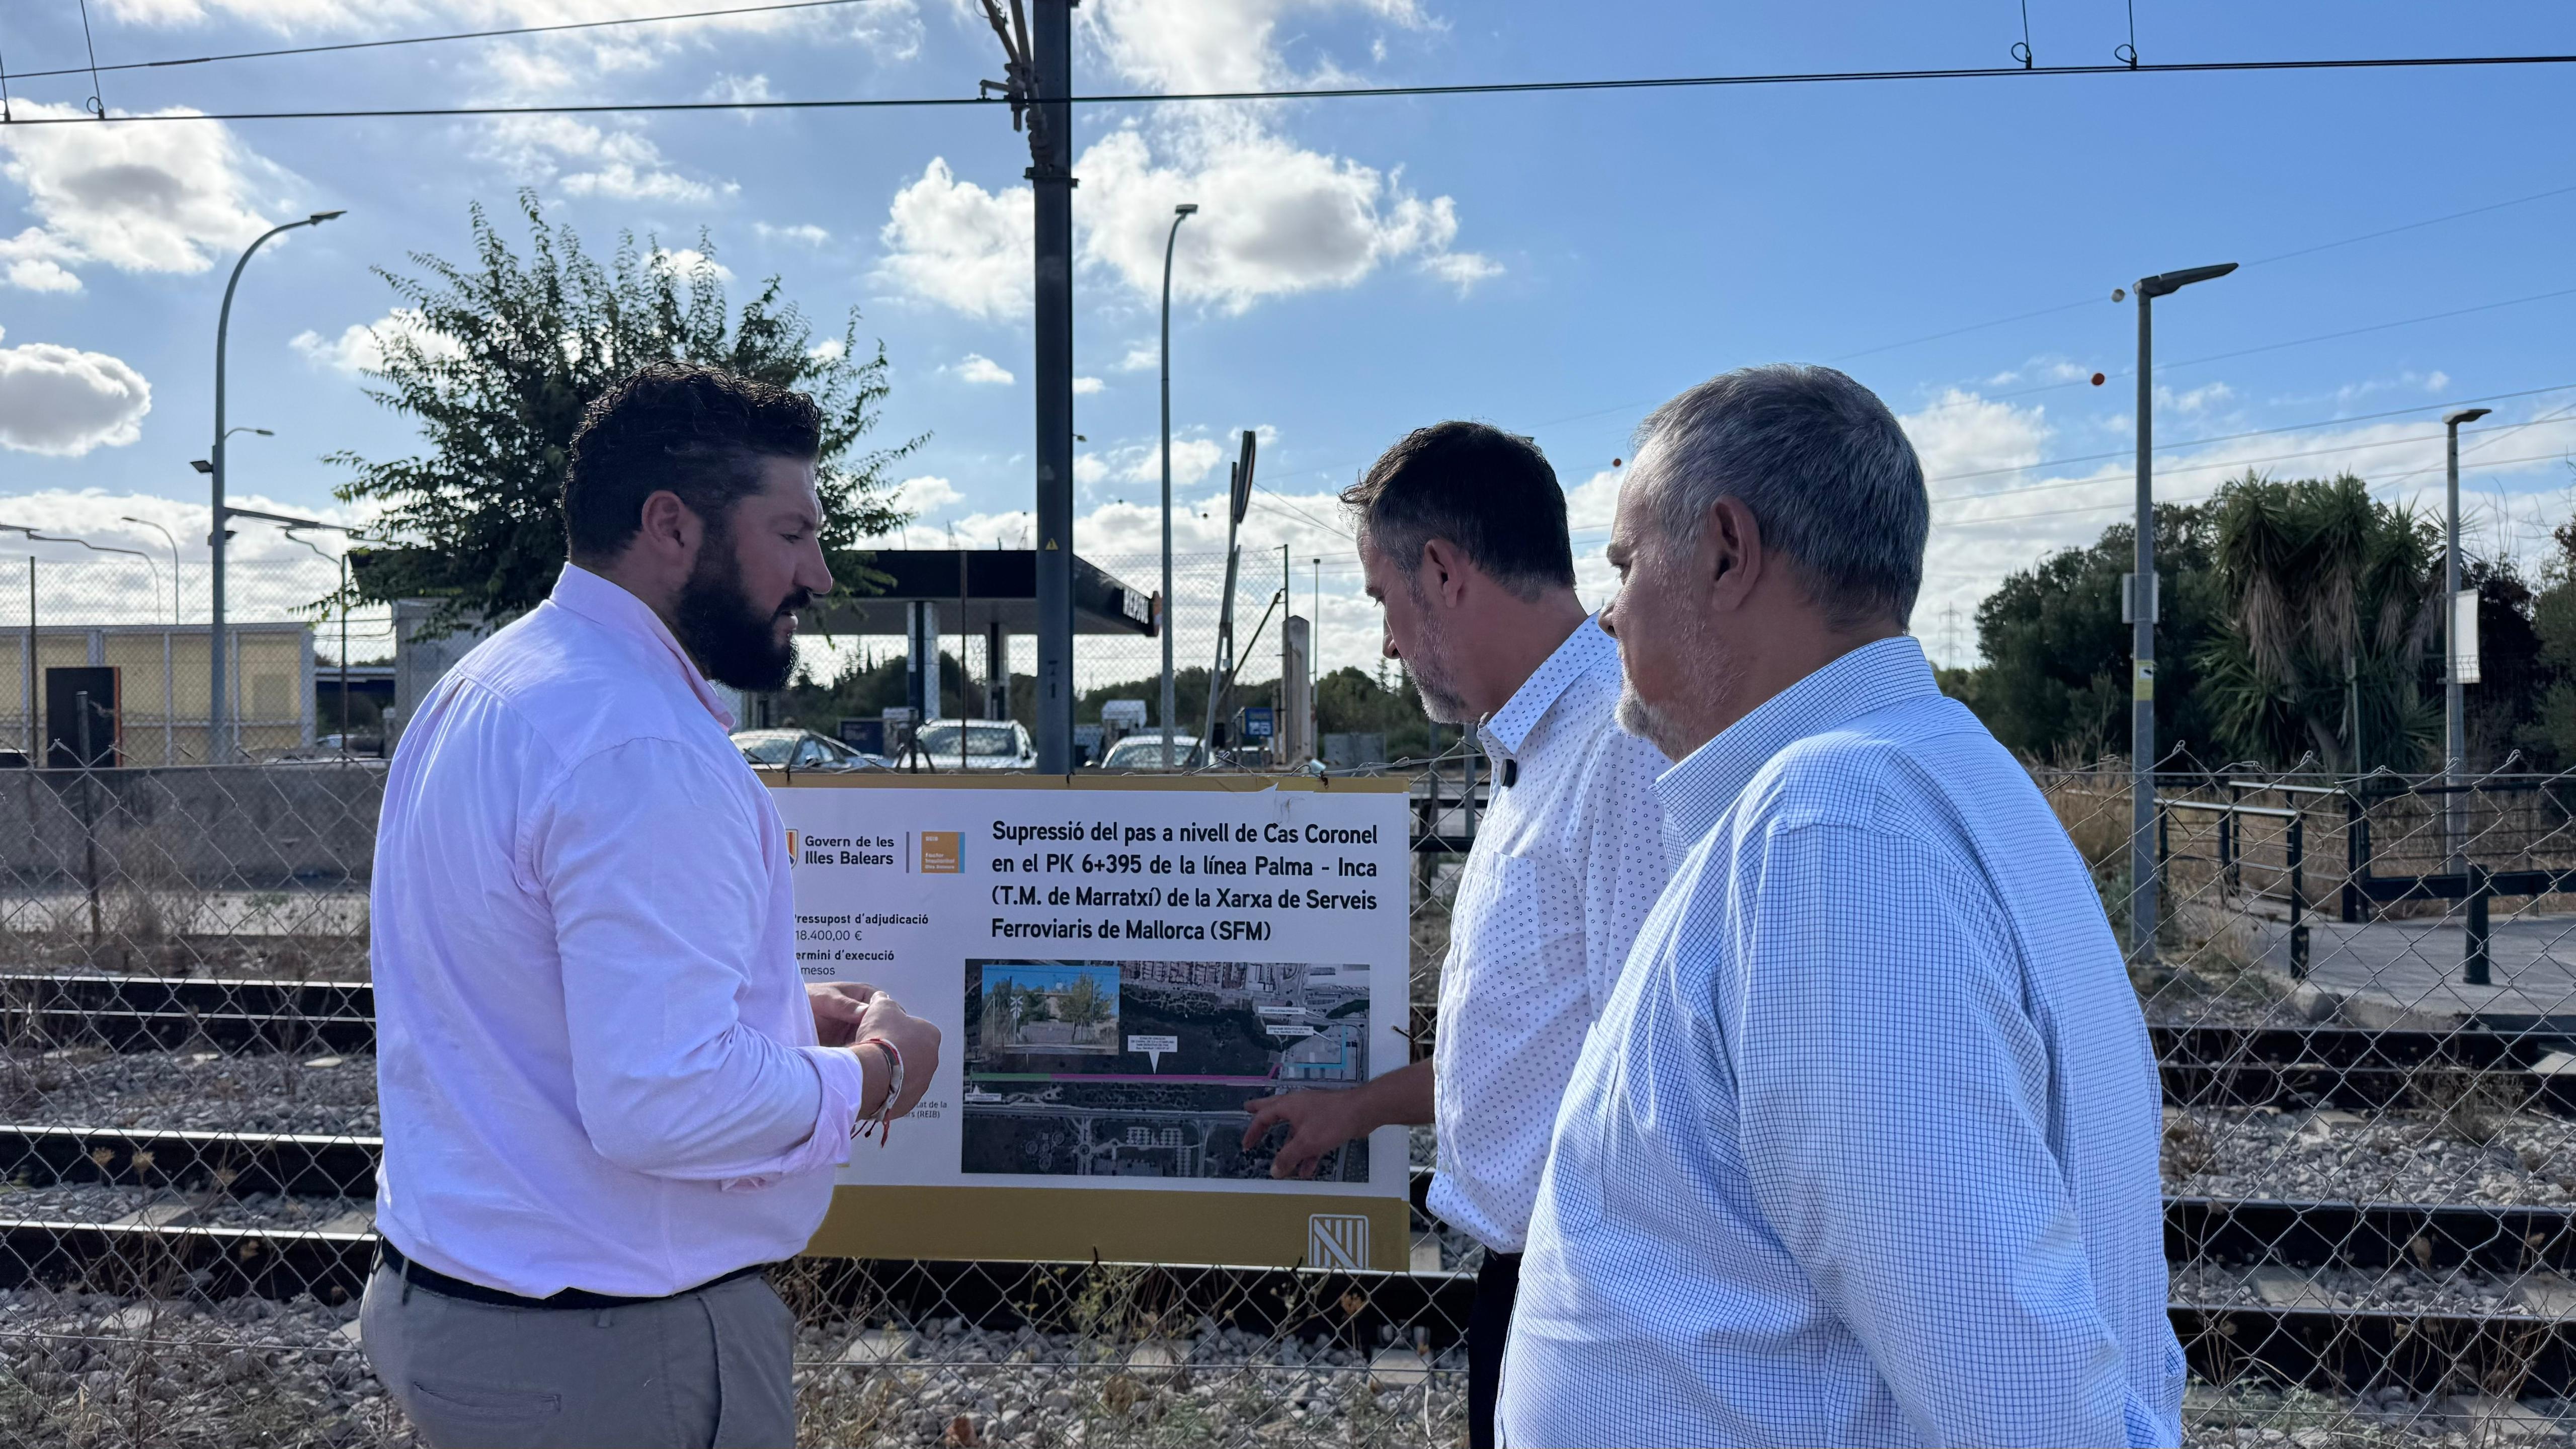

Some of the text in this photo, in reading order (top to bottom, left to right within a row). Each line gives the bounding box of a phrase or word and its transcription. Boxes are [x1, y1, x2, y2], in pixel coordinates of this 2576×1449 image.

[992, 820, 1378, 847] Supressió del pas a nivell de Cas Coronel
[805, 835, 895, 847] Govern de les
[806, 850, 894, 865] Illes Balears
[992, 858, 1014, 872] en
[1022, 853, 1038, 872] el
[1046, 853, 1074, 873] PK
[1082, 853, 1142, 873] 6+395
[1150, 854, 1172, 874] de
[1180, 855, 1195, 874] la
[1203, 855, 1246, 875] línea
[1255, 856, 1313, 876] Palma
[1338, 857, 1377, 877] Inca
[992, 885, 1377, 910] (T.M. de Marratxí) de la Xarxa de Serveis
[794, 913, 928, 926] ressupost d'adjudicació
[795, 930, 862, 942] 18.400,00 €
[992, 918, 1271, 941] Ferroviaris de Mallorca (SFM)
[796, 949, 895, 960] ermini d'execució
[800, 967, 835, 975] mesos
